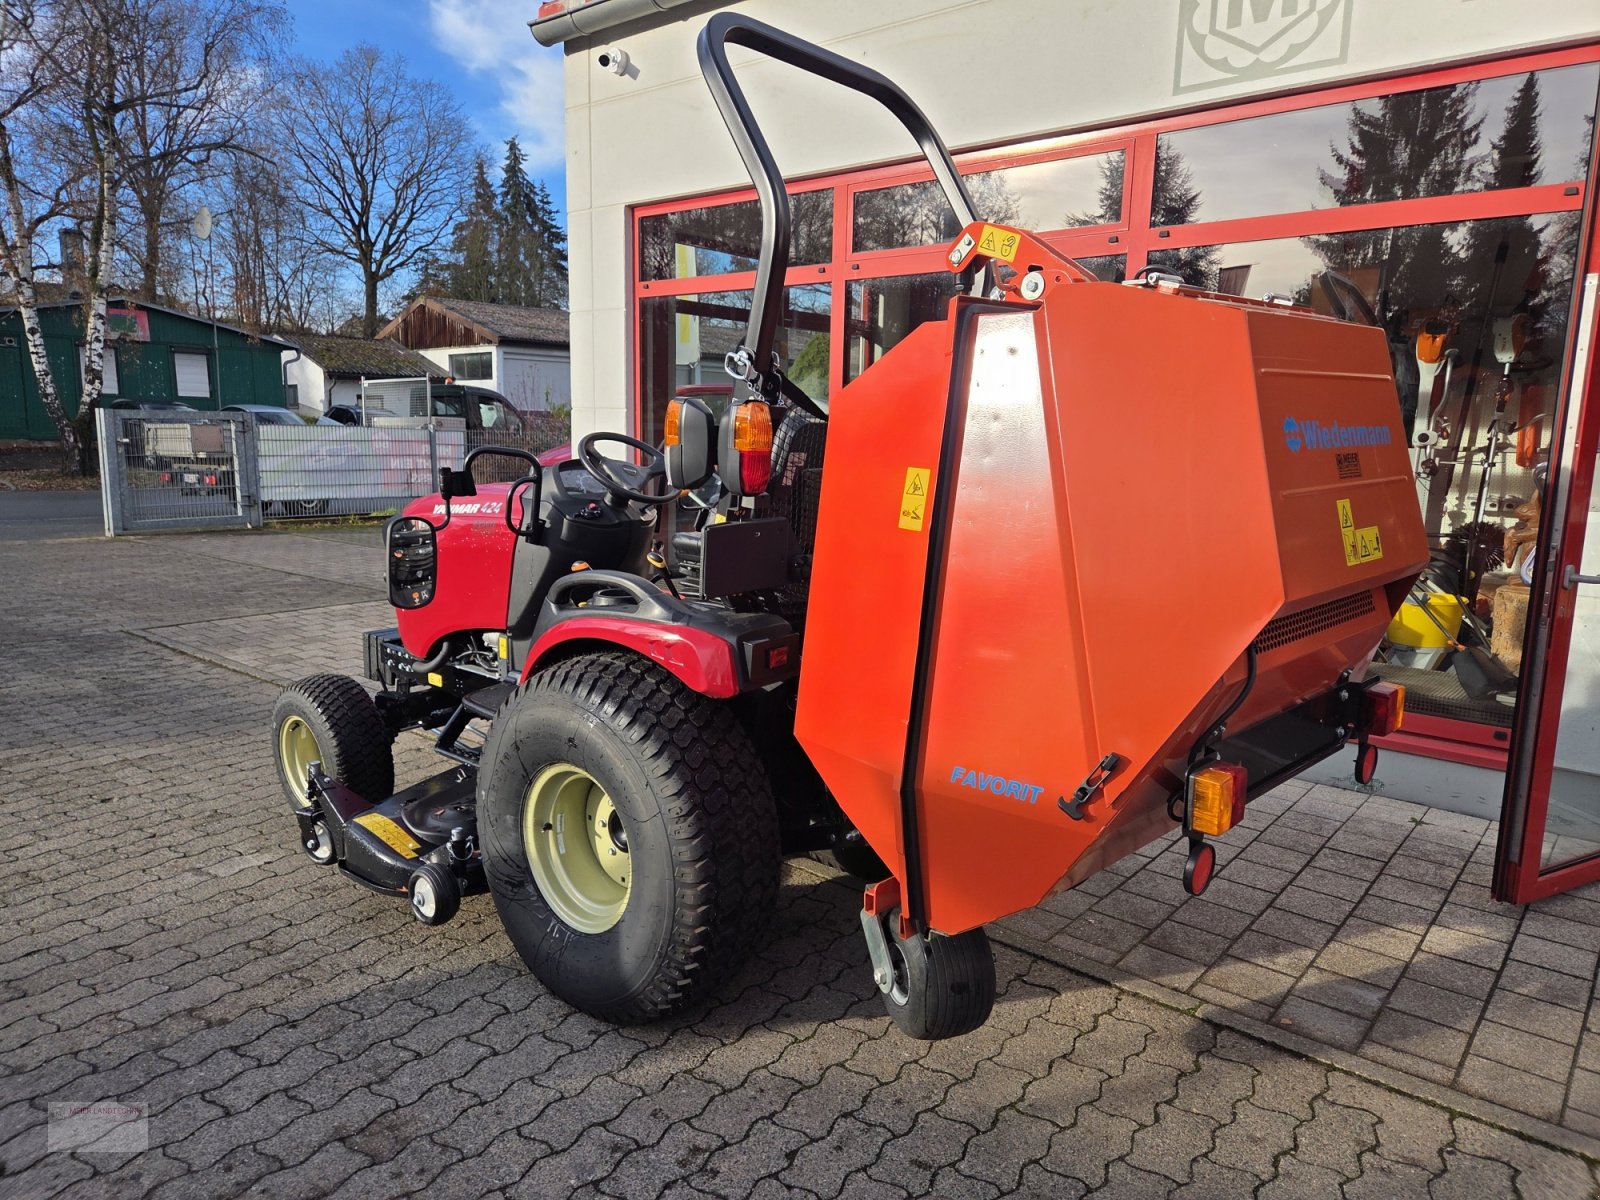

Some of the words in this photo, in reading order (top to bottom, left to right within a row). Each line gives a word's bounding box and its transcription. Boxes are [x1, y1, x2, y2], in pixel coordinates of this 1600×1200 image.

[1301, 420, 1392, 449] Wiedenmann
[481, 502, 502, 513] 424
[950, 766, 1044, 804] FAVORIT
